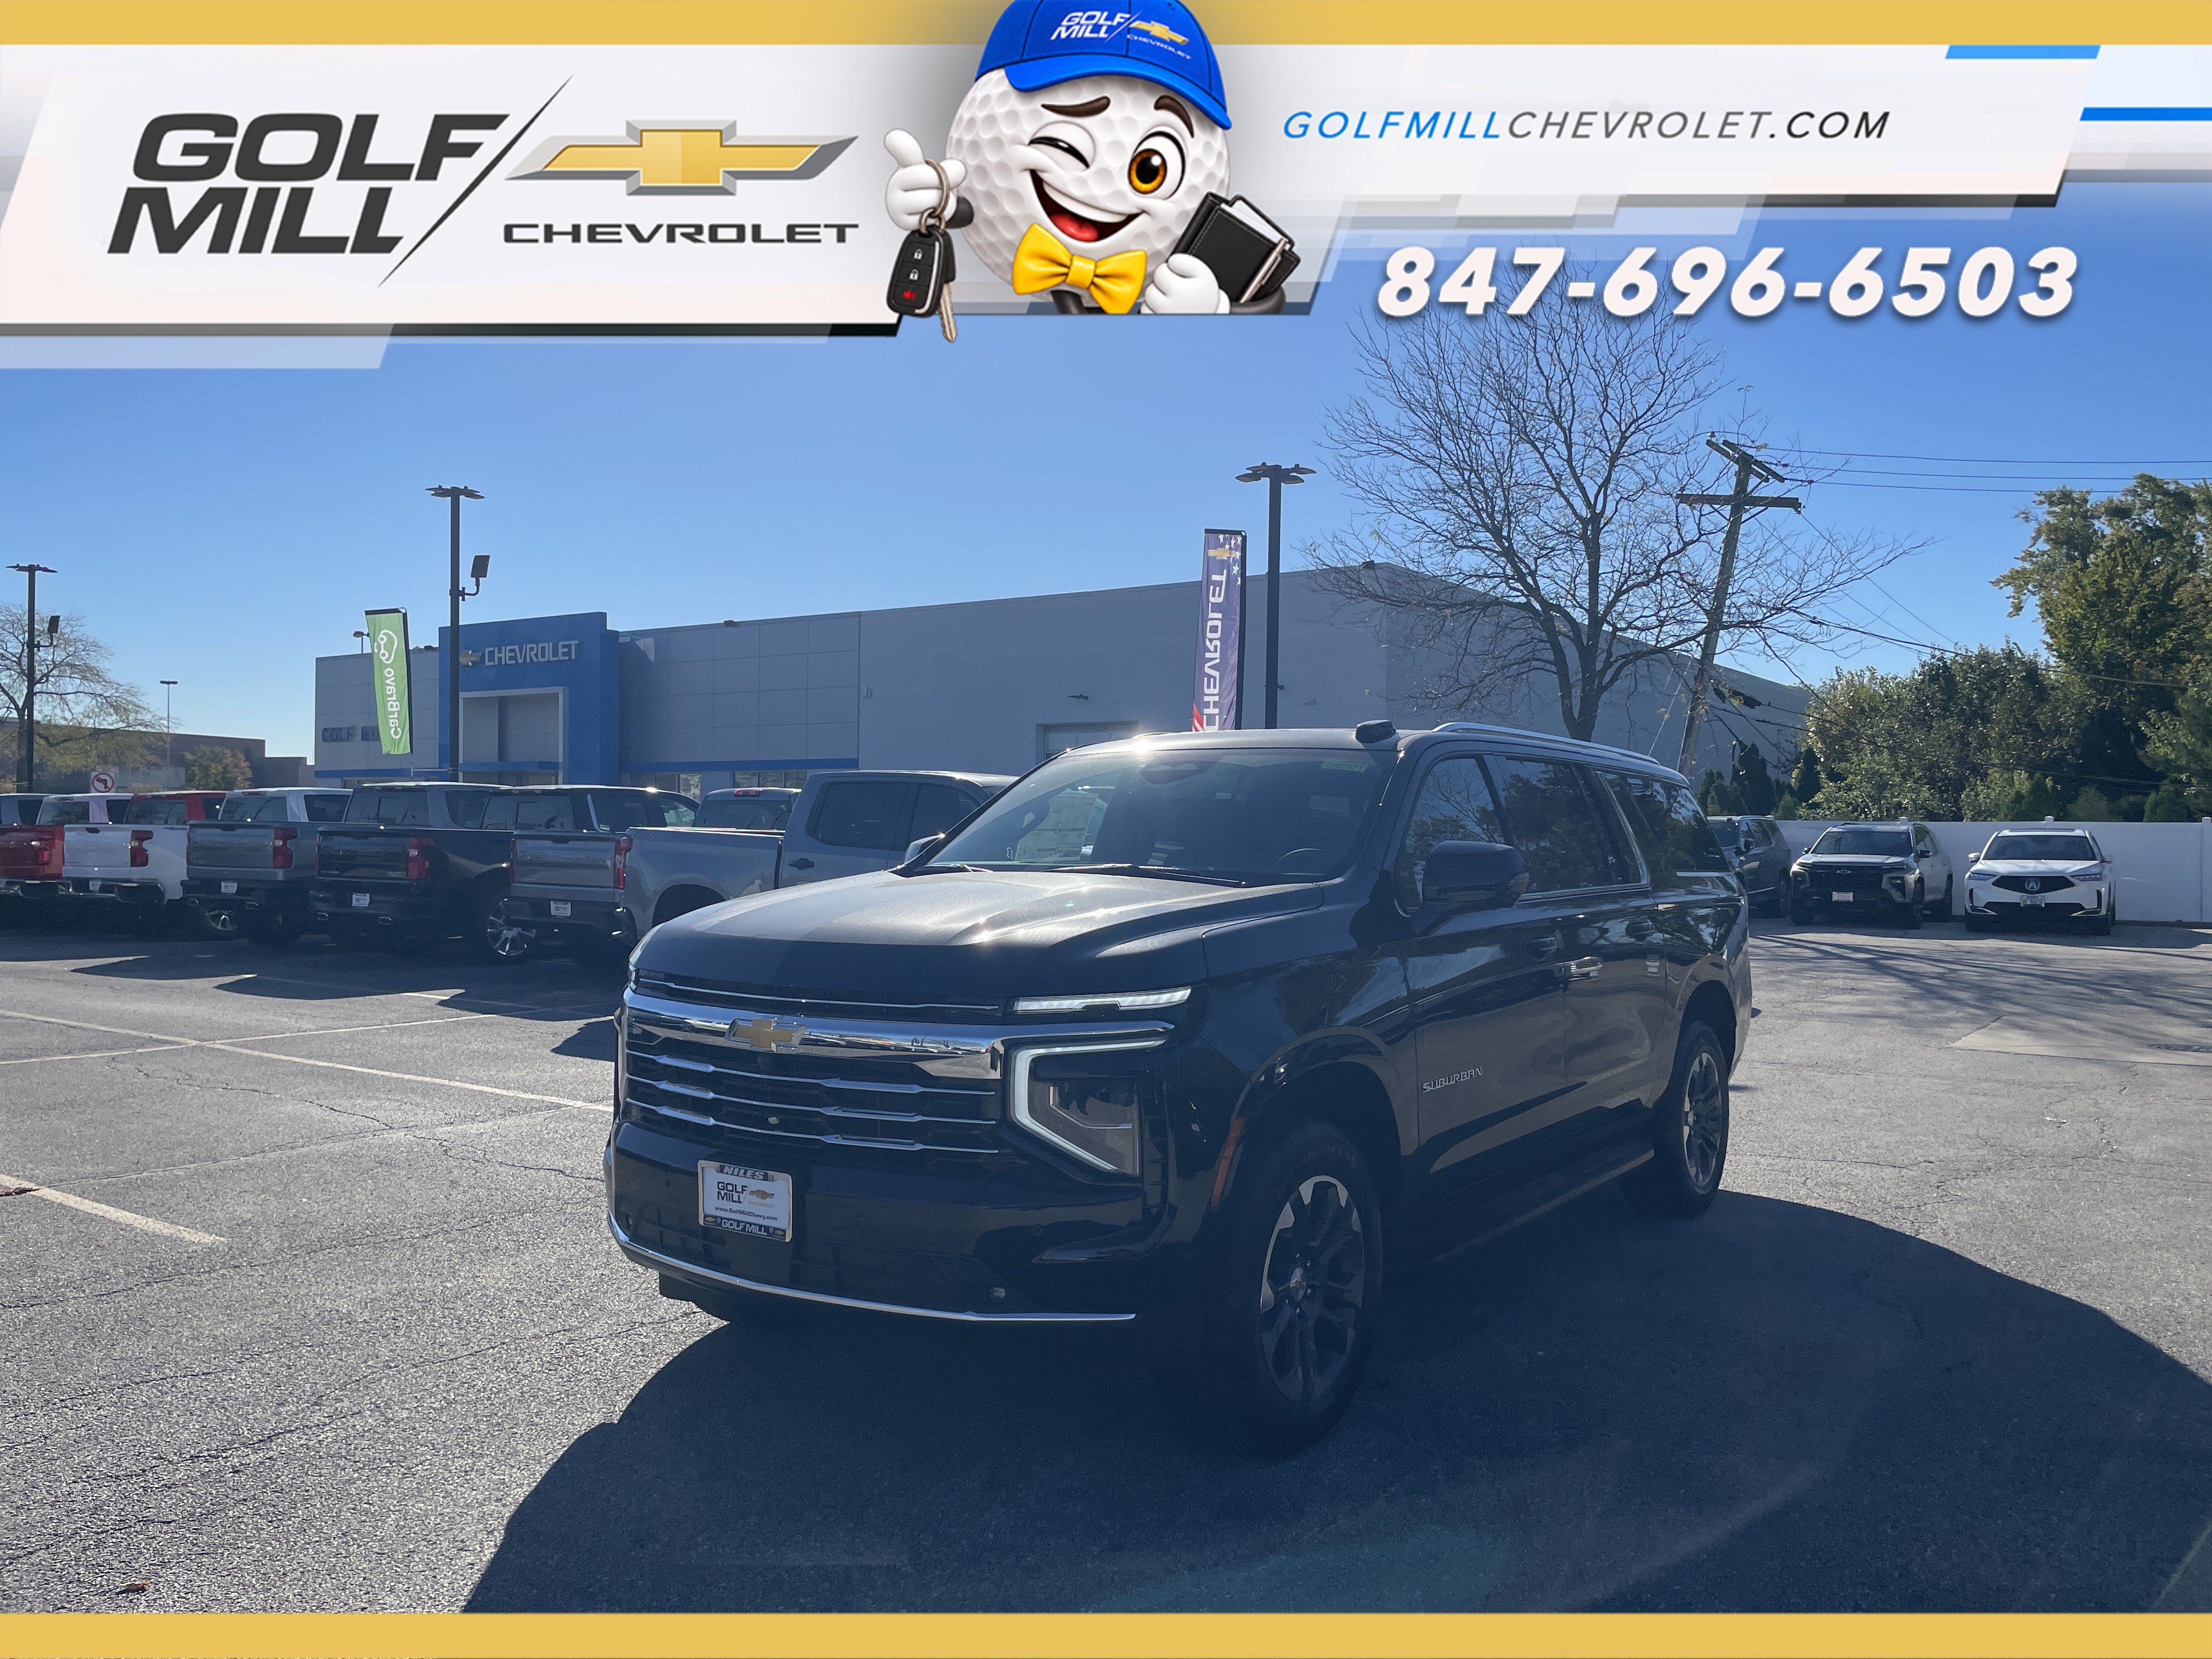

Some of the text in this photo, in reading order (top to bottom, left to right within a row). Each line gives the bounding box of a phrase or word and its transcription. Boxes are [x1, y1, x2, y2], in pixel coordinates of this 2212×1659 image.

[485, 640, 579, 666] CHEVROLET
[1422, 1066, 1482, 1093] SUBURBAN
[723, 1166, 765, 1180] NILES
[717, 1181, 748, 1194] GOLF
[717, 1191, 743, 1204] MILL
[721, 1218, 768, 1235] GOLF MILL
